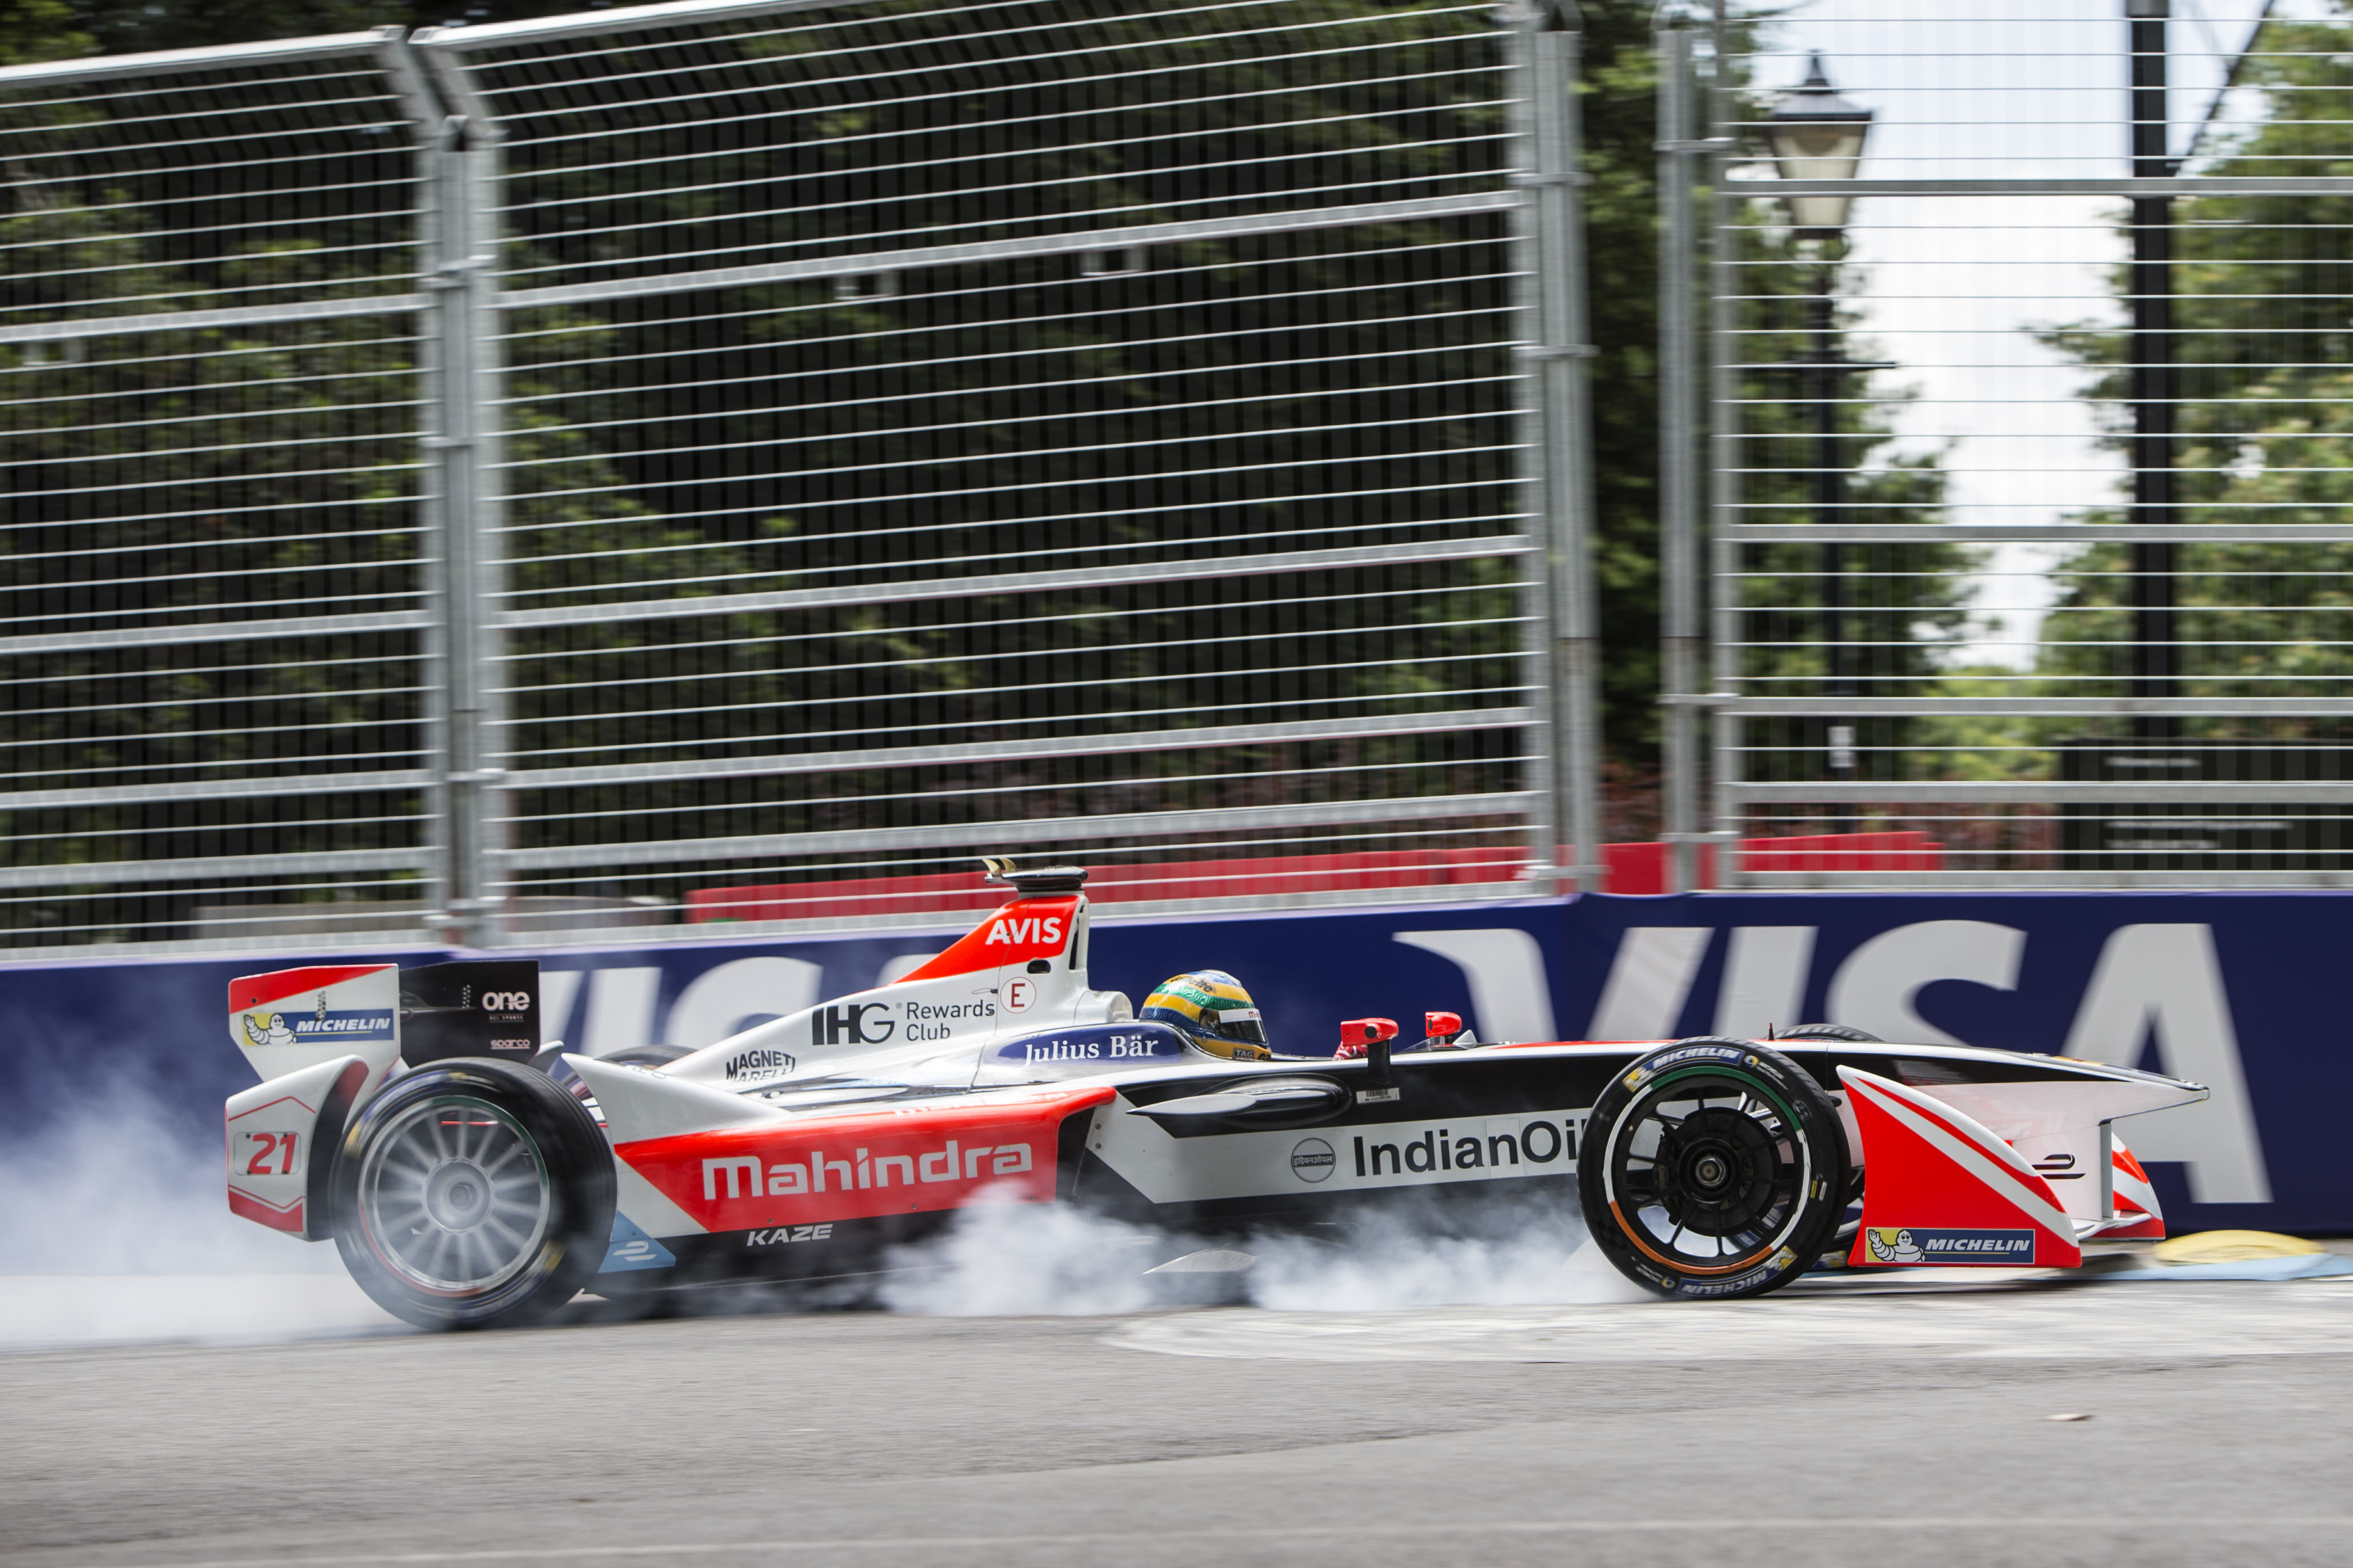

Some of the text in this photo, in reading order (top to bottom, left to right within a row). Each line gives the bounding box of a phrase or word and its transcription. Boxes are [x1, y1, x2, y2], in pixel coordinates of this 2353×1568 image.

[986, 917, 1062, 945] AVIS
[482, 991, 530, 1011] one
[1011, 983, 1025, 1008] E
[906, 1000, 995, 1020] Rewards
[295, 1017, 391, 1033] MICHELIN
[813, 1002, 895, 1045] IHG
[906, 1022, 951, 1041] Club
[490, 1039, 530, 1049] sparco
[1025, 1035, 1159, 1067] Julius Bär
[1235, 1049, 1254, 1058] TAG
[726, 1050, 795, 1076] MAGNETI
[1652, 1047, 1742, 1070] MICHELIN
[248, 1133, 297, 1175] 21
[703, 1140, 1033, 1200] Mahindra
[746, 1223, 833, 1246] KAZE
[1926, 1238, 2031, 1252] MICHELIN
[1681, 1269, 1768, 1294] MICHELIN
